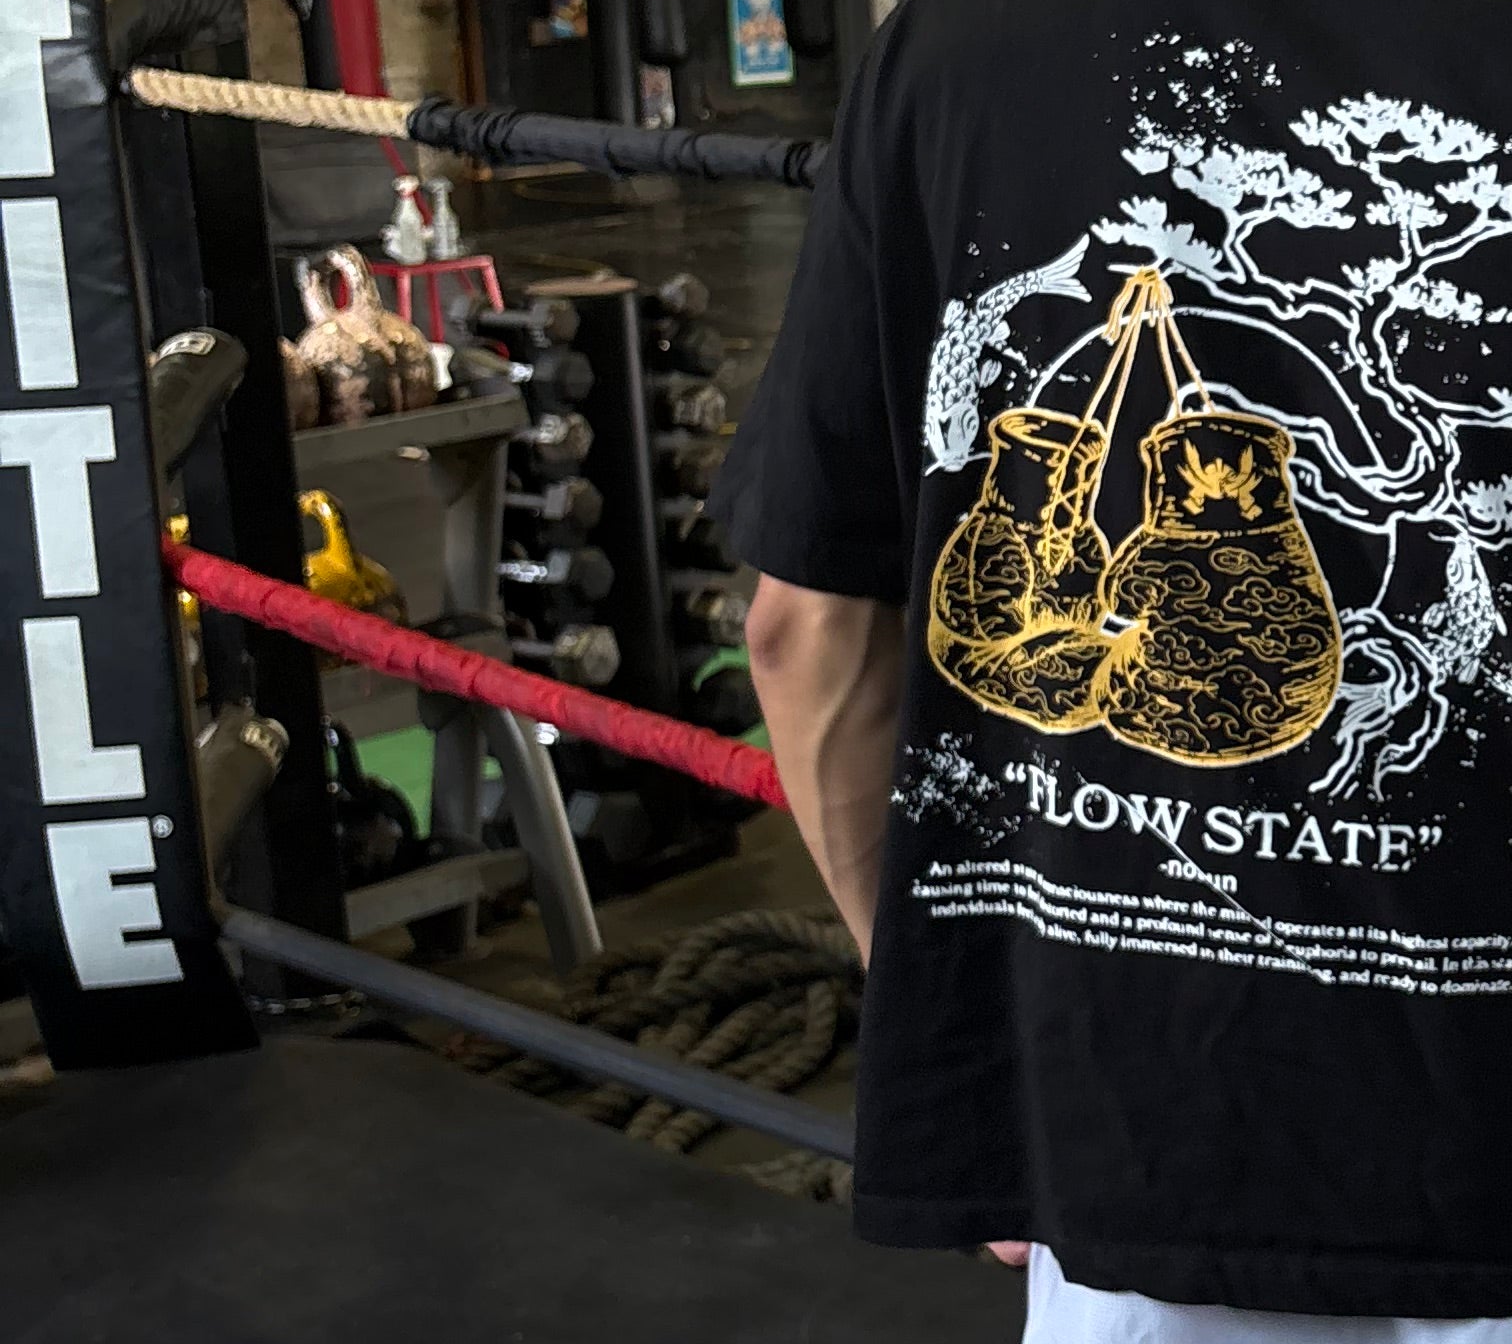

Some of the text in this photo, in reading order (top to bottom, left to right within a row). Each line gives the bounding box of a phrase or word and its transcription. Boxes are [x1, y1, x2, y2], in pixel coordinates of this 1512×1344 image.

[912, 881, 973, 898] causing
[976, 878, 1010, 894] time
[1089, 910, 1120, 927] and
[1122, 915, 1133, 929] a
[1136, 915, 1205, 938] profound
[1207, 926, 1252, 945] sense
[1253, 930, 1273, 946] of
[1283, 937, 1358, 960] euphoria
[1360, 948, 1379, 964] to
[1441, 956, 1459, 973] In
[1461, 955, 1490, 971] this
[929, 860, 952, 878] An
[956, 858, 1010, 876] altered
[1141, 894, 1190, 915] where
[1192, 899, 1218, 919] the
[1274, 919, 1345, 940] operates
[1347, 925, 1365, 940] at
[1367, 924, 1389, 943] its
[1390, 929, 1450, 952] highest
[930, 898, 1015, 919] individuals
[1046, 923, 1082, 945] alive,
[1084, 928, 1119, 952] fully
[1119, 934, 1198, 957] immersed
[1199, 946, 1215, 961] in
[1216, 945, 1255, 967] their
[1339, 968, 1371, 985] and
[1373, 972, 1419, 995] ready
[1420, 979, 1440, 996] to
